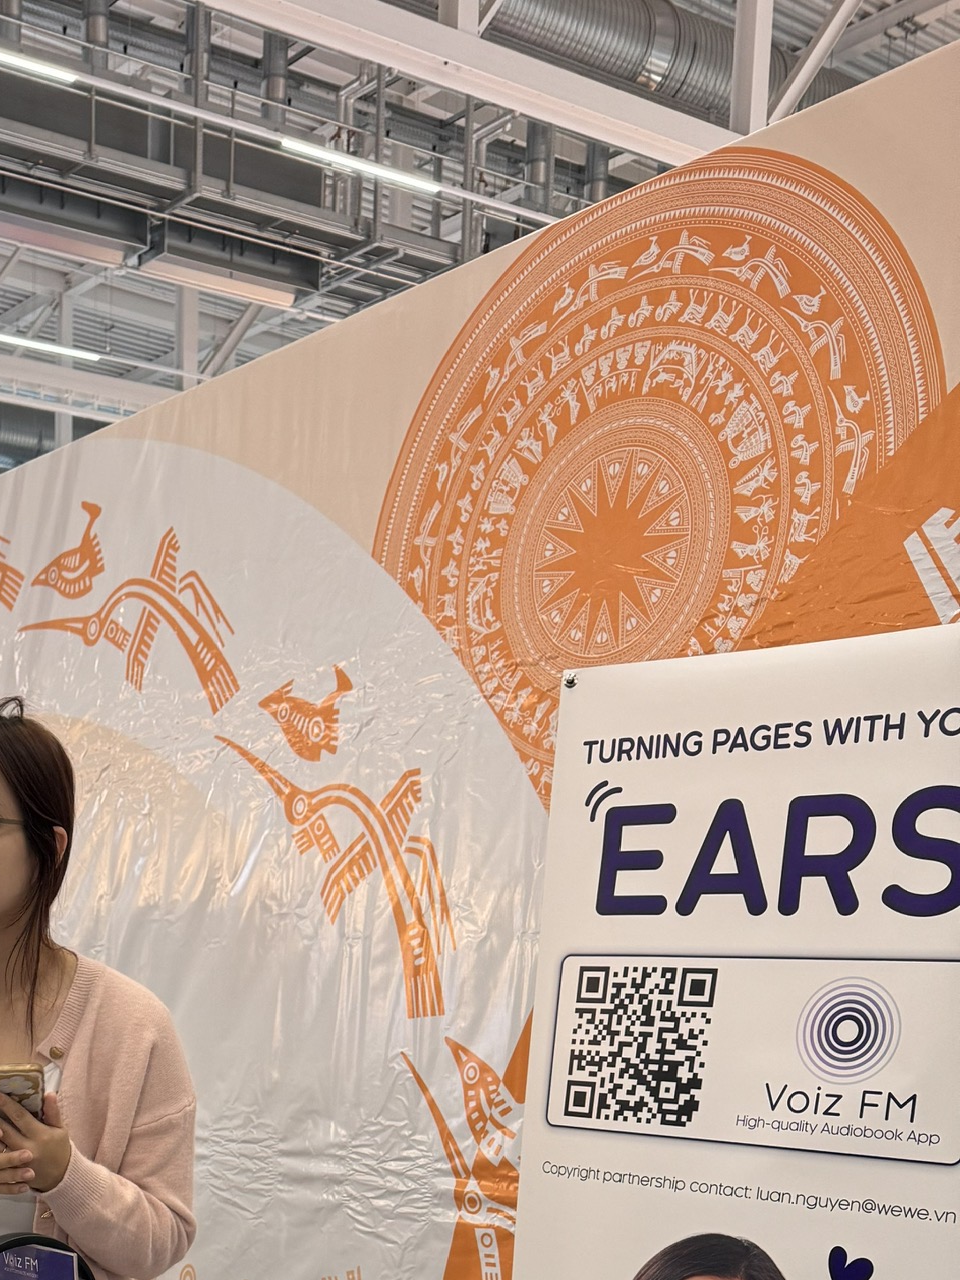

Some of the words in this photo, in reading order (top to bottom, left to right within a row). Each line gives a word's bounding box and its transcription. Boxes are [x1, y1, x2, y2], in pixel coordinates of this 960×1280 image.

[583, 730, 703, 764] TURNING
[711, 720, 813, 755] PAGES
[823, 712, 906, 746] WITH
[917, 707, 960, 738] YO
[595, 784, 960, 918] EARS
[765, 1082, 843, 1117] Voiz
[859, 1090, 917, 1123] FM
[735, 1114, 818, 1136] High-quality
[820, 1122, 903, 1141] Audiobook
[906, 1130, 941, 1146] App
[542, 1161, 600, 1182] Copyright
[602, 1169, 686, 1193] partnership
[689, 1180, 752, 1199] contact:
[756, 1186, 957, 1224] luan.nguyen@wewe.vn
[2, 1251, 22, 1268] Voiz
[24, 1256, 39, 1272] FM
